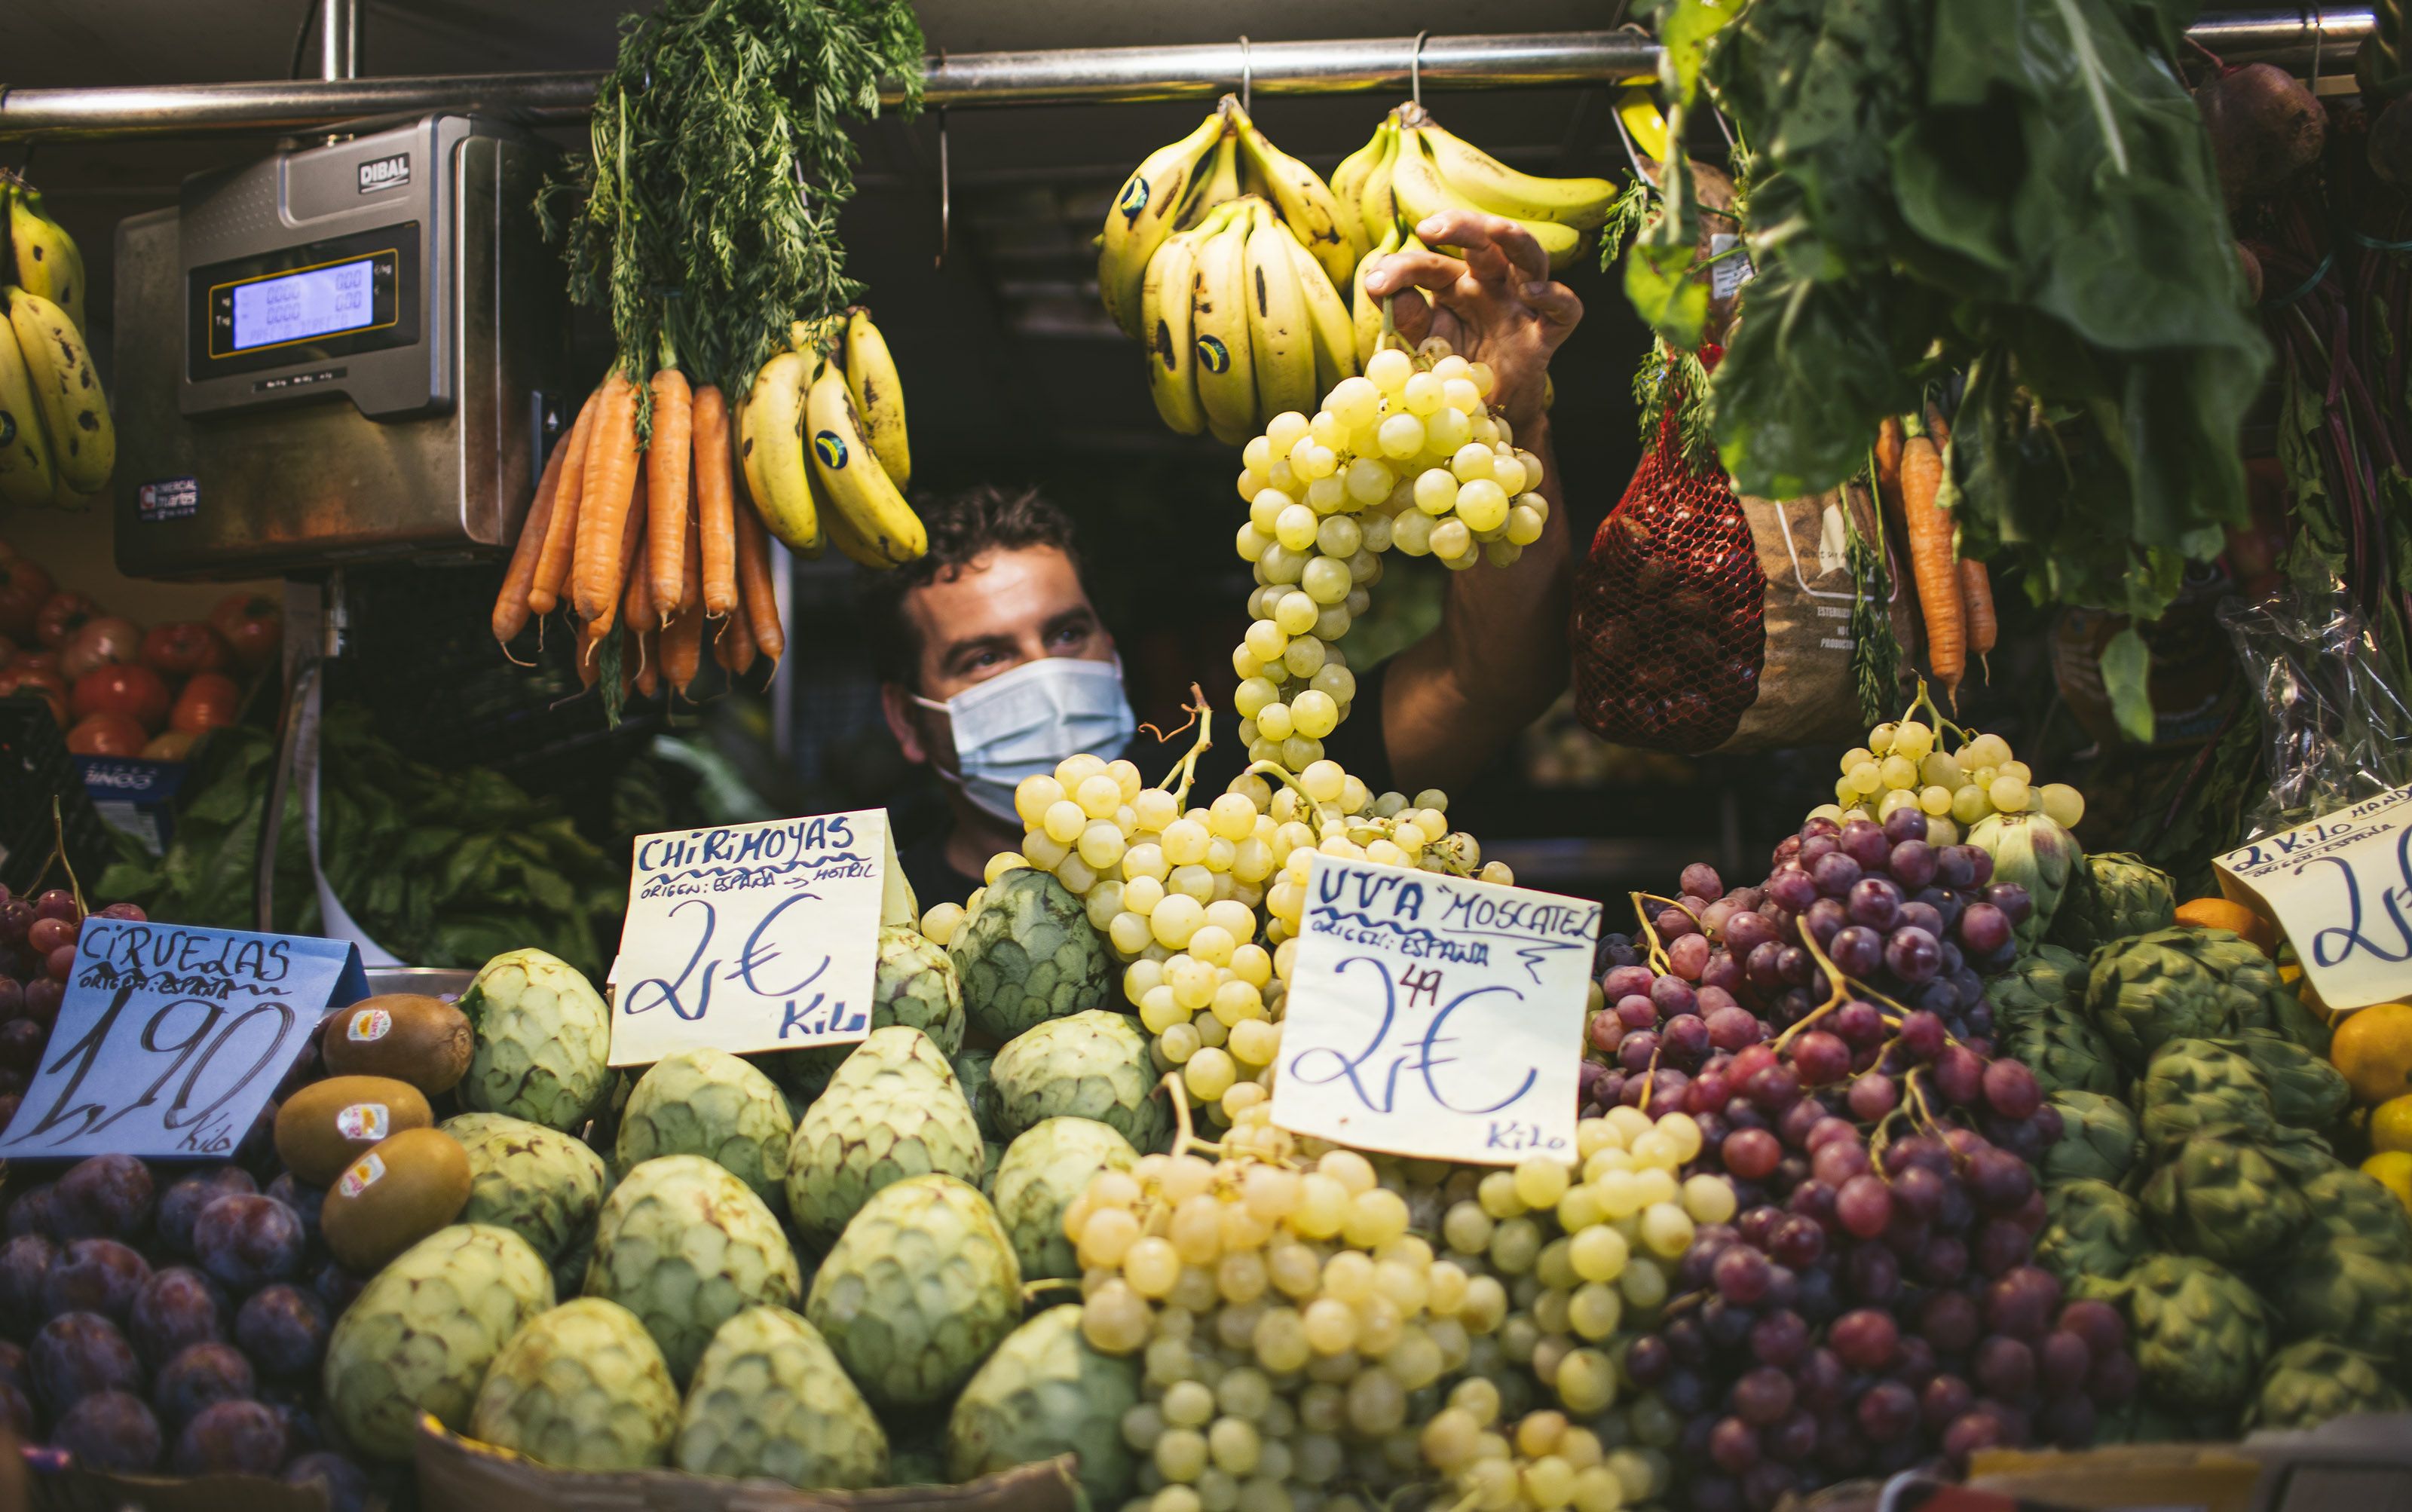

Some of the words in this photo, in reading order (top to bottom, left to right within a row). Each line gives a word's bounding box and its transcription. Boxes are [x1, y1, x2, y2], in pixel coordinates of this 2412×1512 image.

[360, 157, 409, 185] DIBAL
[1319, 867, 1425, 920] UVA
[1399, 963, 1443, 1008] 49
